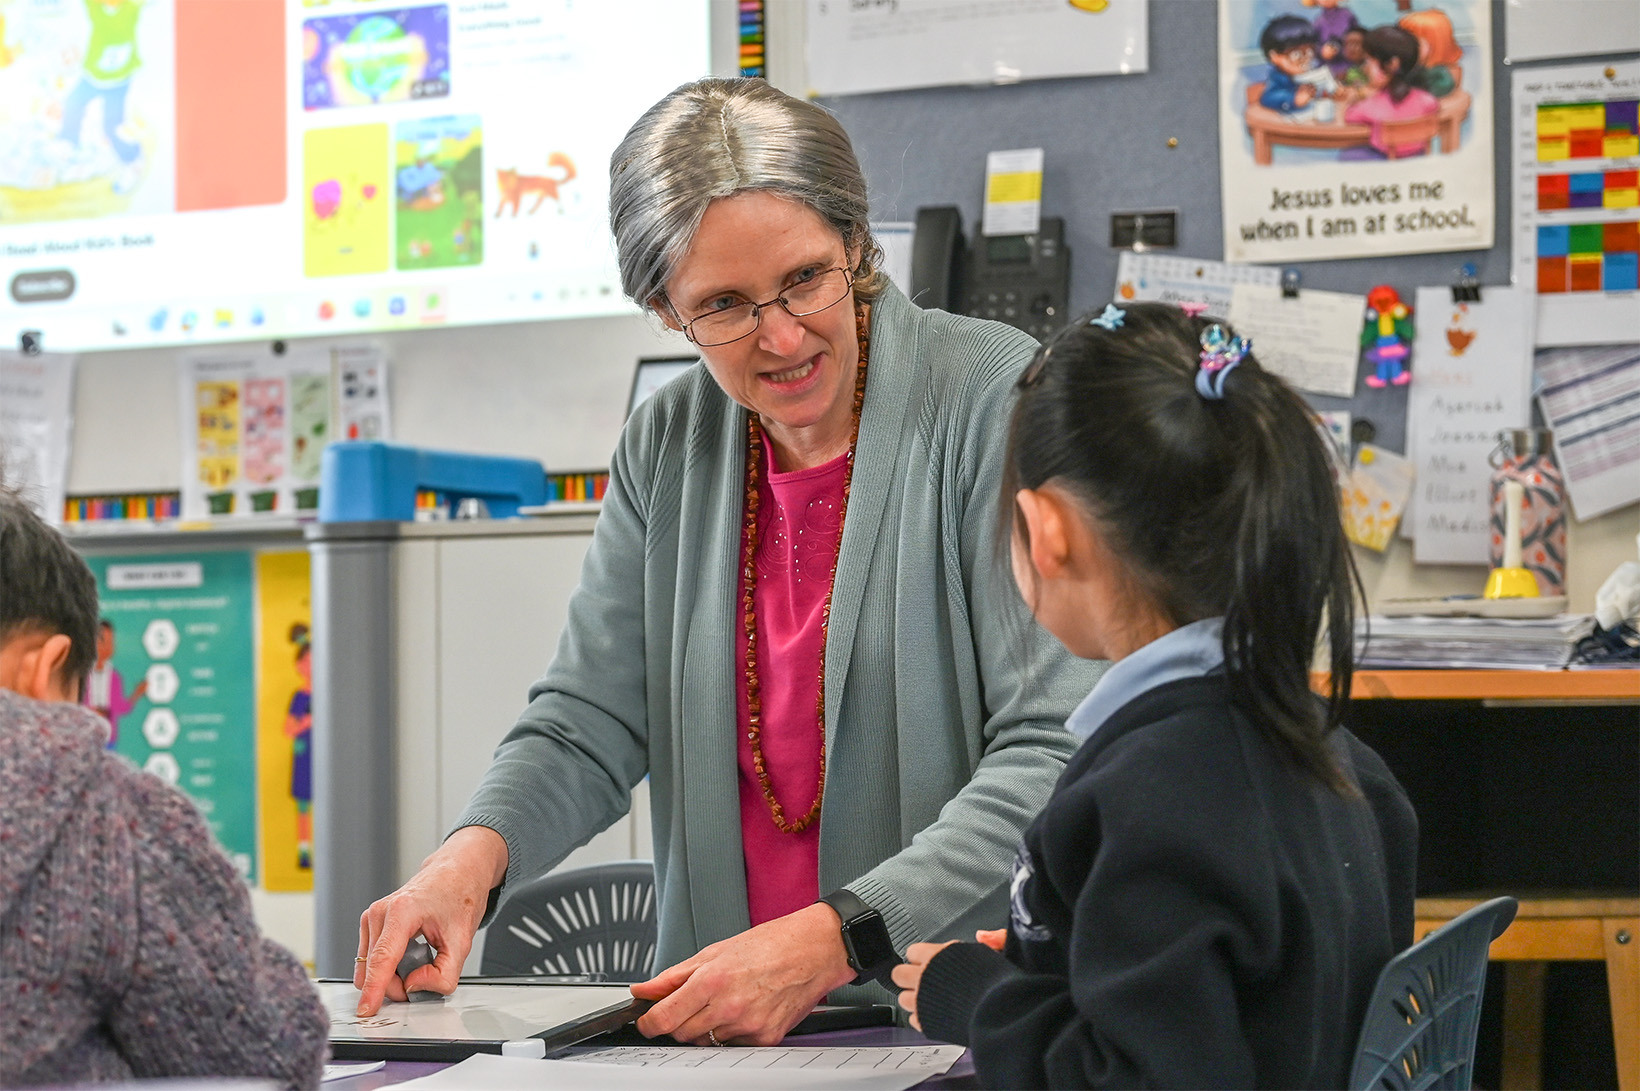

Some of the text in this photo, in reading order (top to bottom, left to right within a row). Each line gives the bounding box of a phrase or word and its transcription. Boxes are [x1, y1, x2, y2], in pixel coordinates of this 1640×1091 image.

[1270, 180, 1444, 211] Jesus loves me
[1240, 203, 1475, 242] when I am at school.
